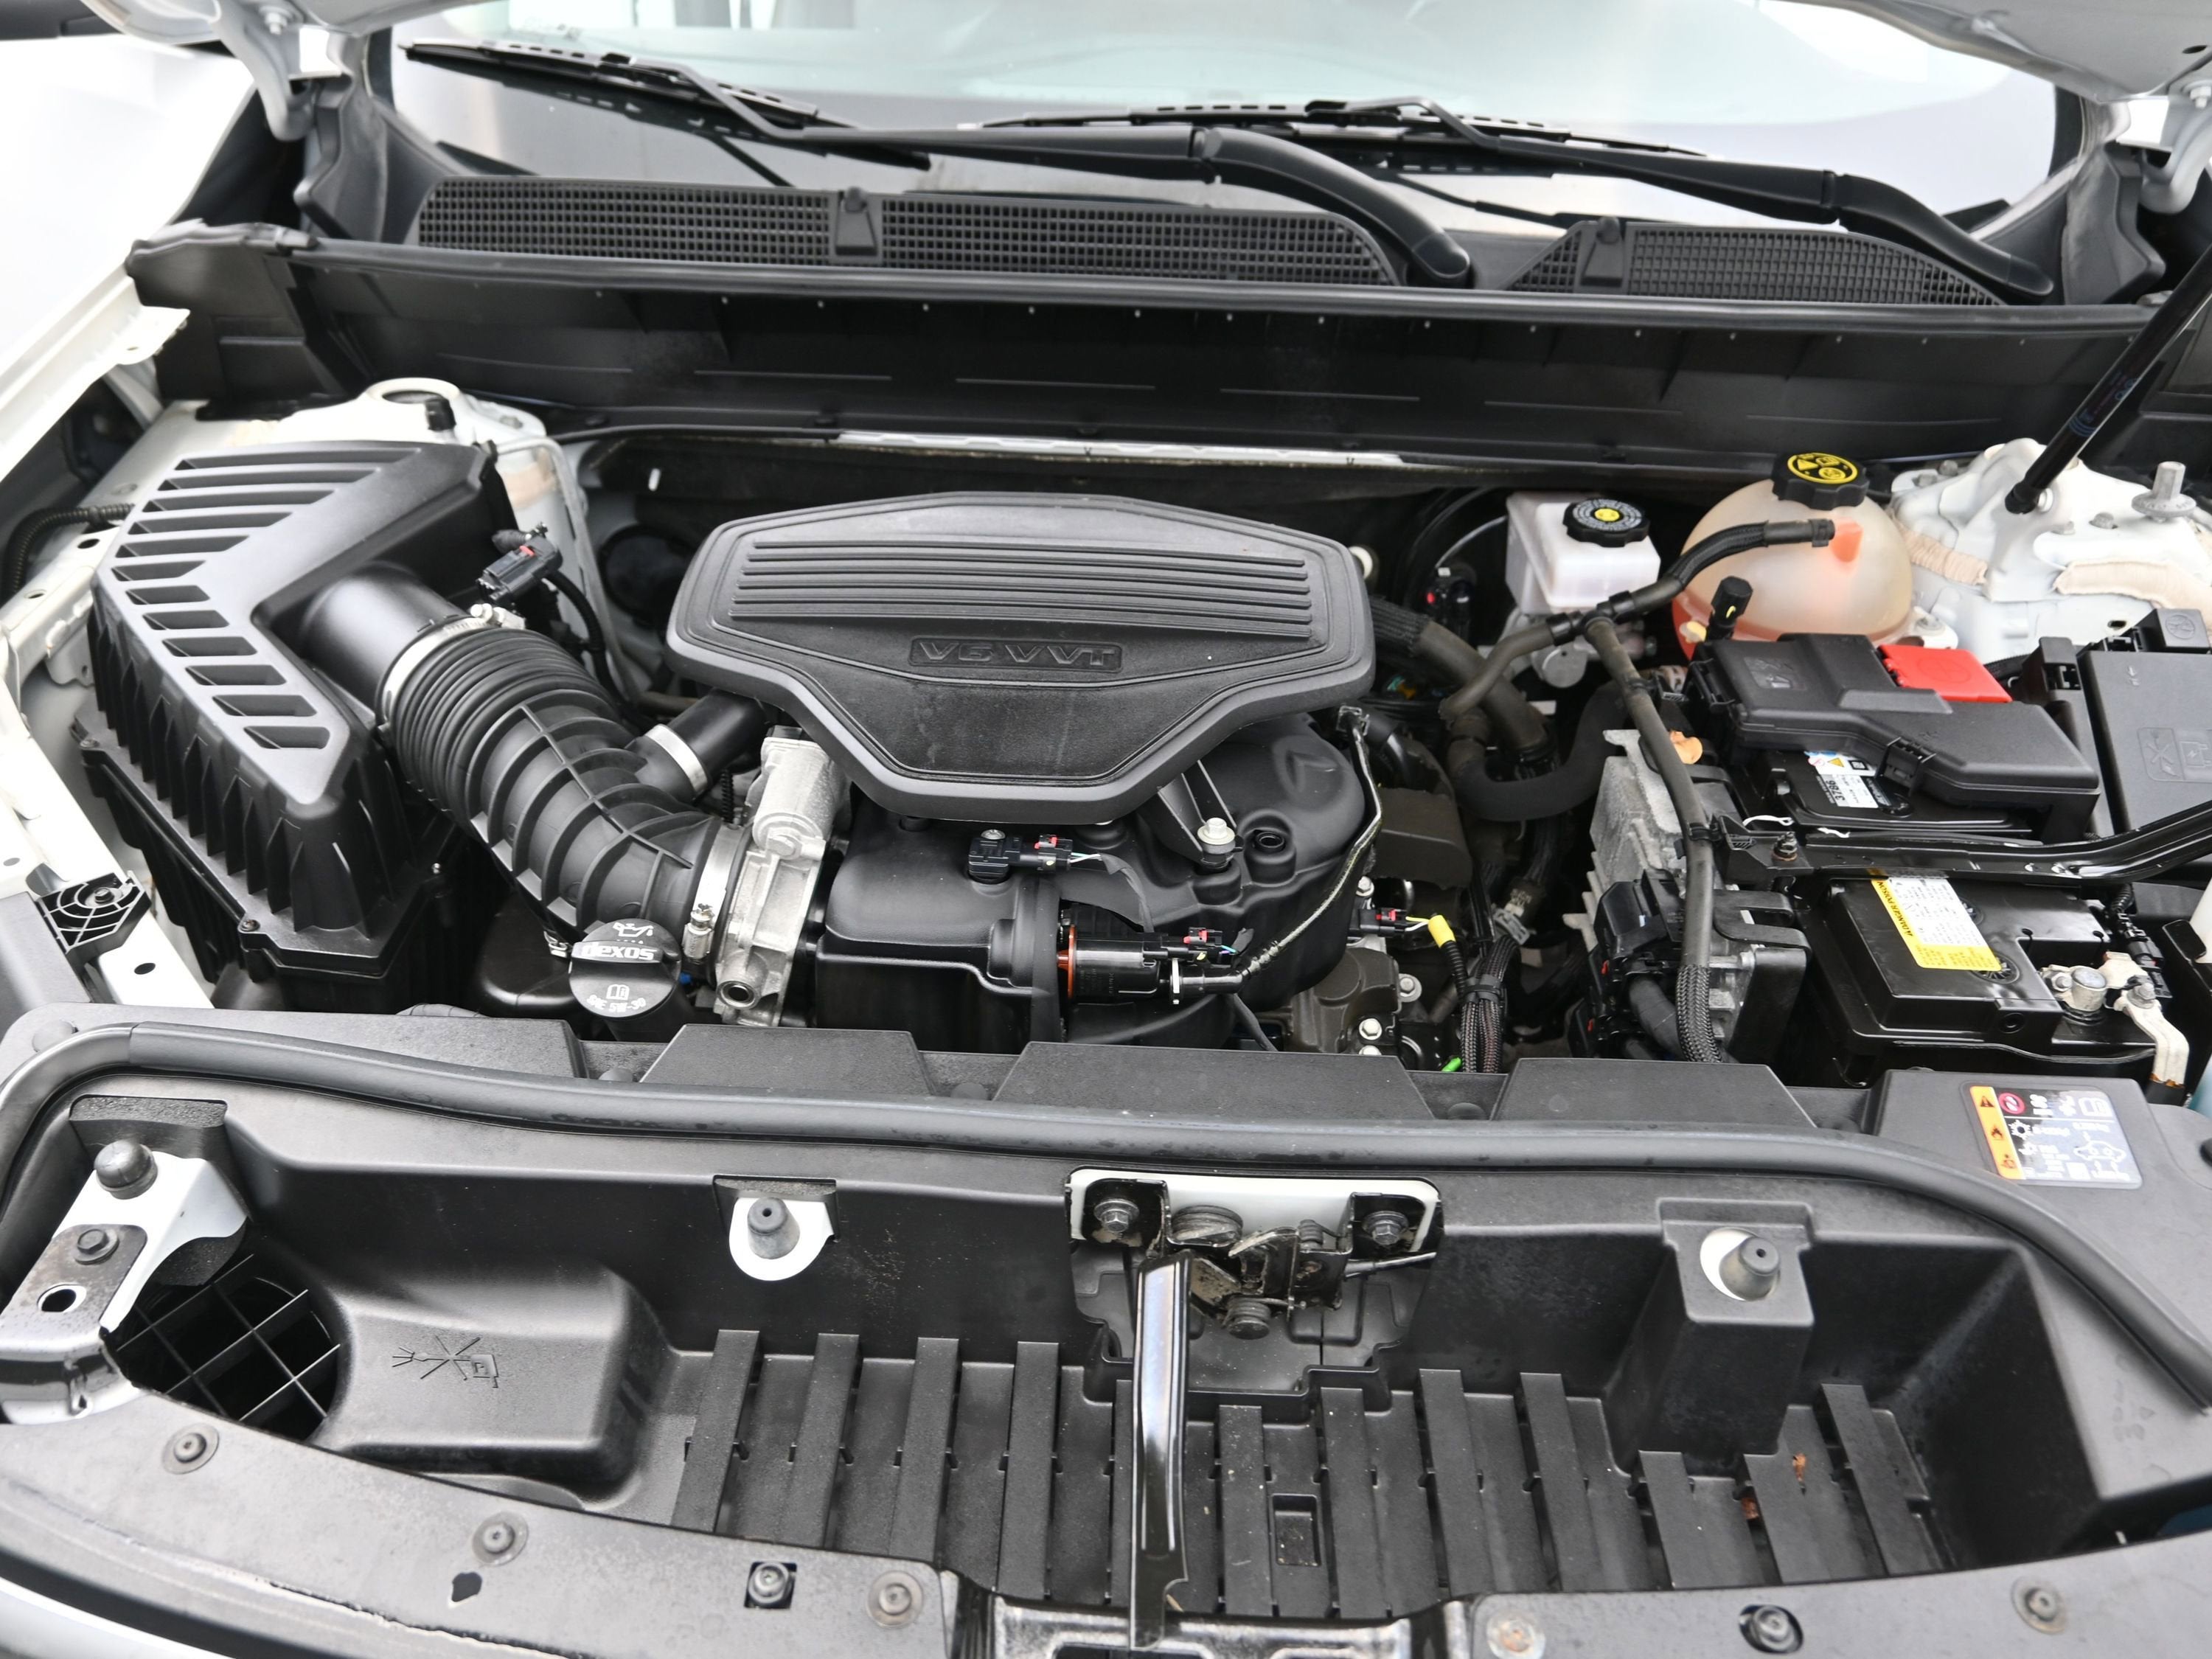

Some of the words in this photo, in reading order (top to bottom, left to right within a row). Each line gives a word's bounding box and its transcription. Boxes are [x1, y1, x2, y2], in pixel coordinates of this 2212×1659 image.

[919, 641, 994, 662] V6
[1005, 644, 1116, 667] VVT
[1825, 779, 1846, 801] 3786
[1877, 881, 1895, 904] POISON
[1890, 905, 1910, 930] DANGER
[581, 942, 658, 961] dexos
[586, 994, 608, 1010] SAE
[608, 997, 647, 1013] 5W-30
